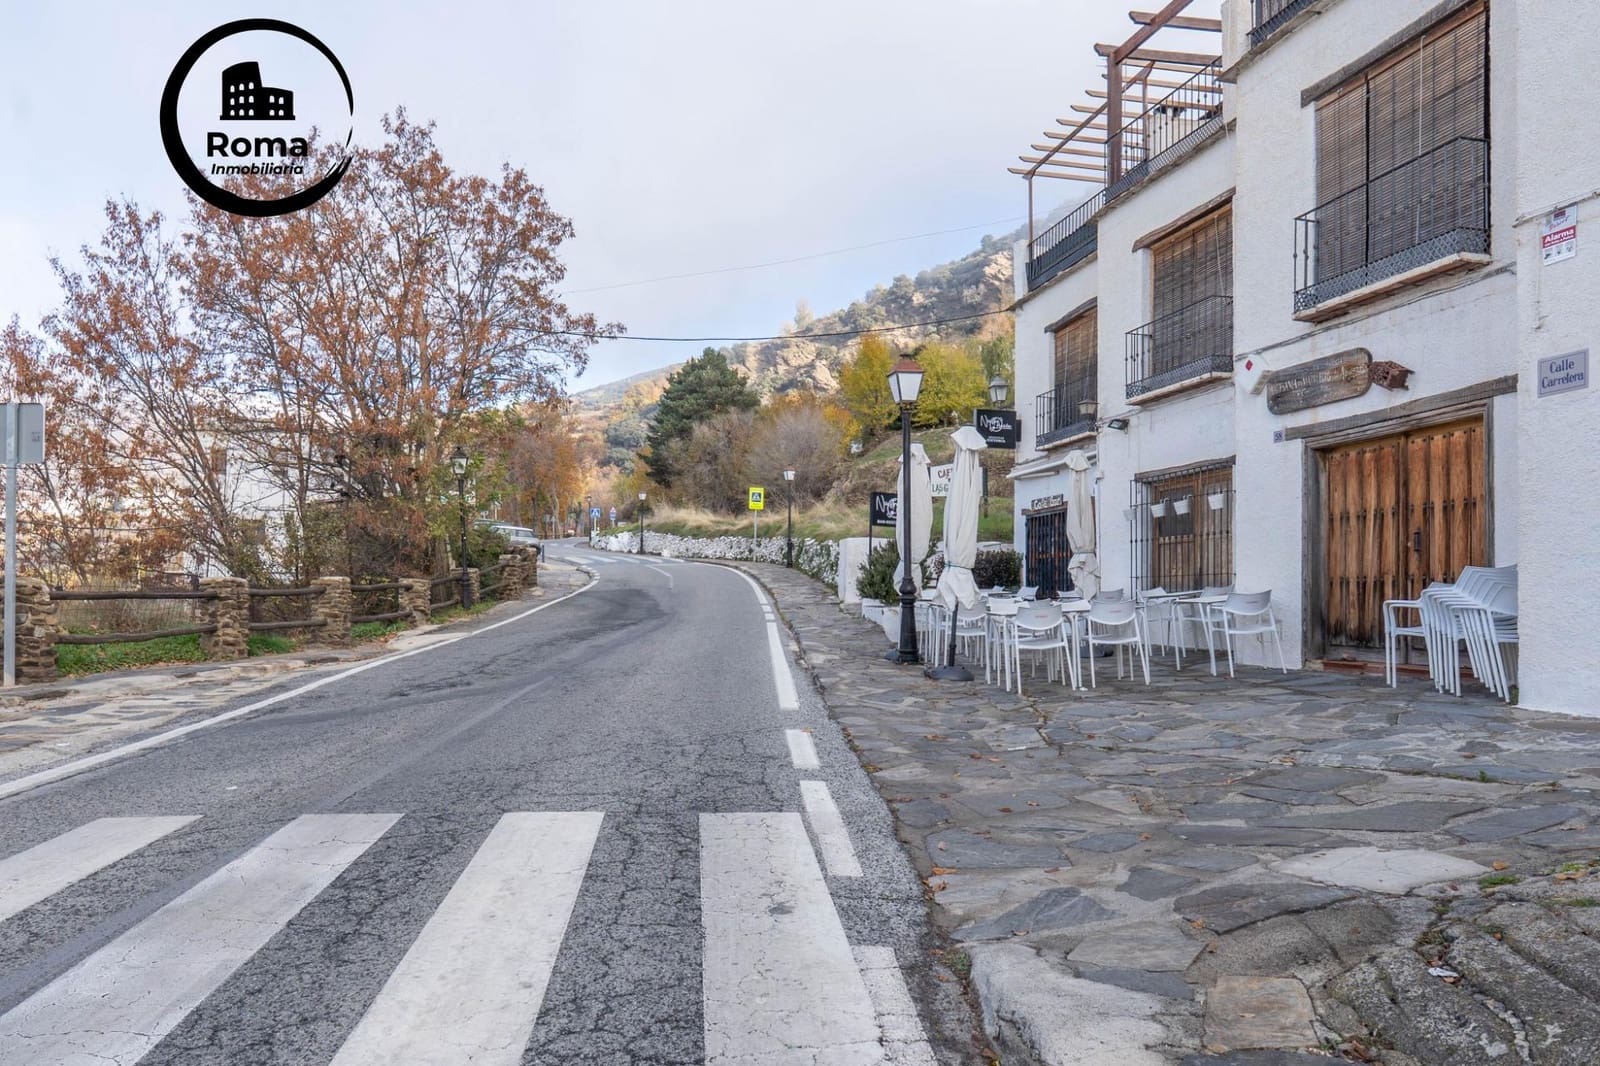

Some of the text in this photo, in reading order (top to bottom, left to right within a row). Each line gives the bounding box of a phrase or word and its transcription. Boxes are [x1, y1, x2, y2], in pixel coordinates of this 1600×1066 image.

[1544, 229, 1574, 244] Alarma
[1549, 358, 1575, 374] Calle
[1541, 371, 1584, 389] Carretera
